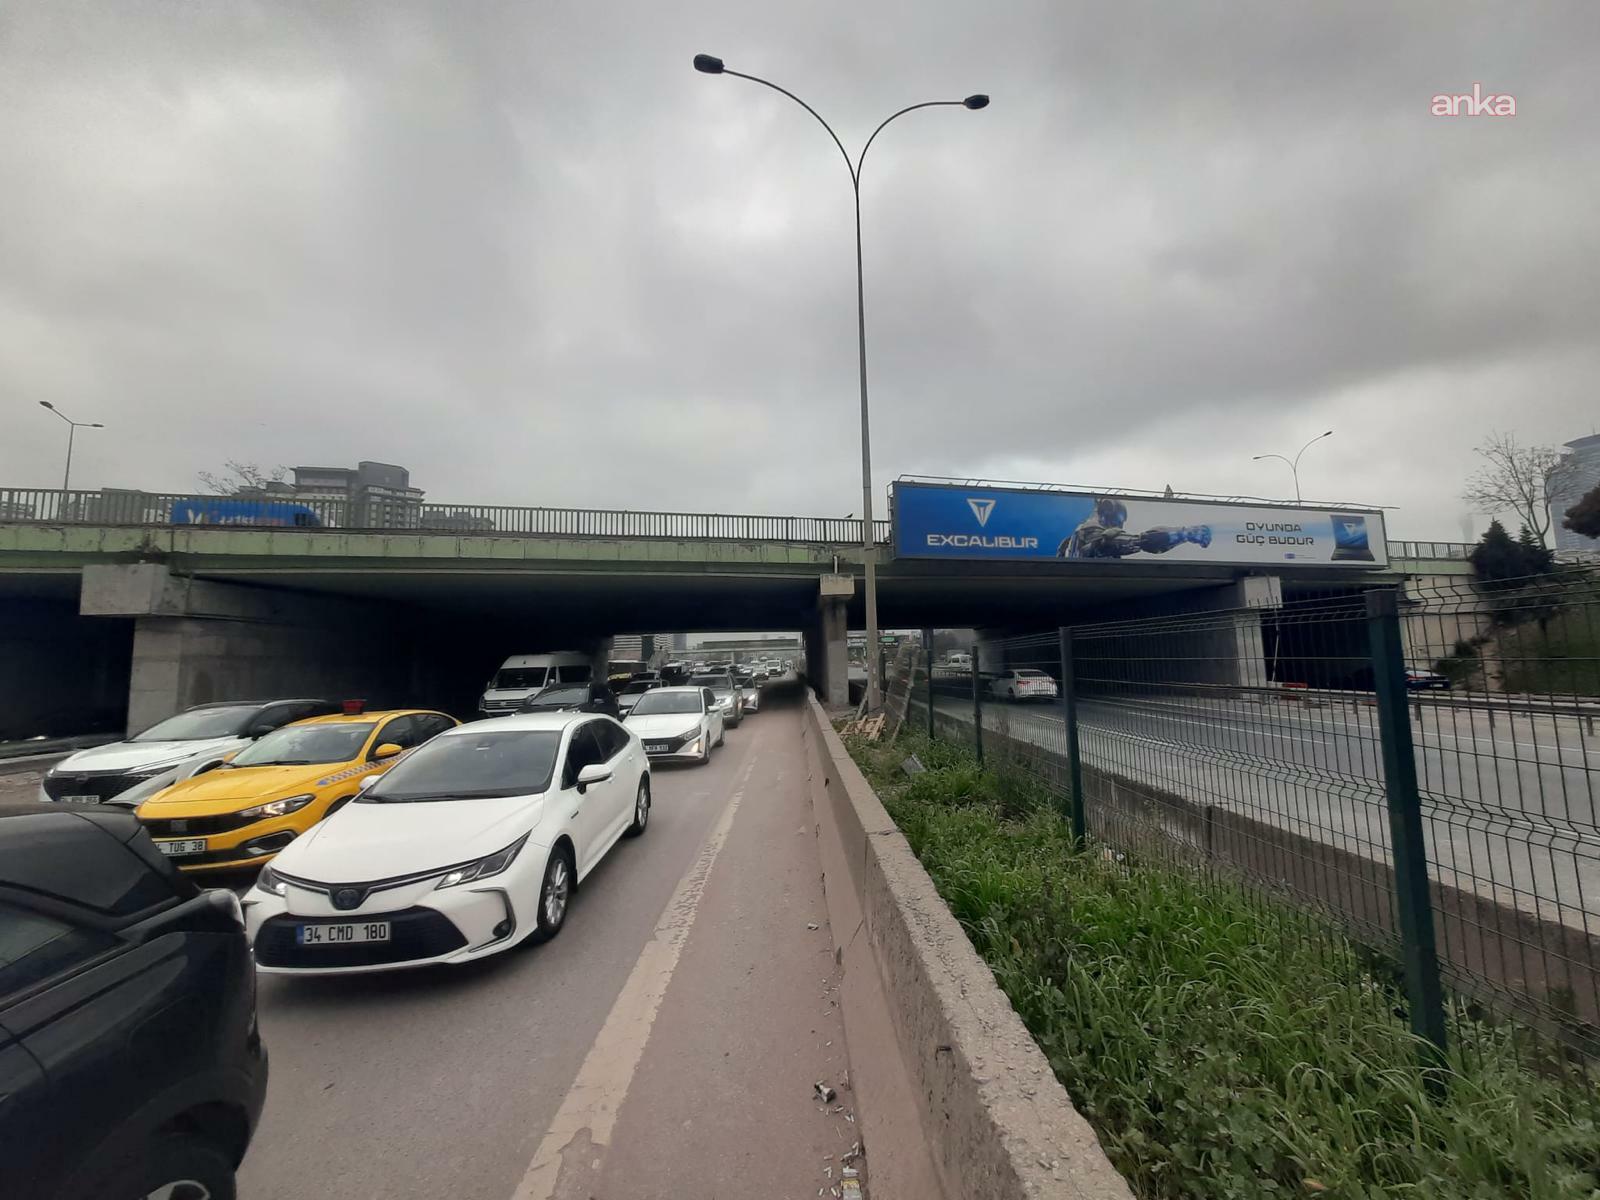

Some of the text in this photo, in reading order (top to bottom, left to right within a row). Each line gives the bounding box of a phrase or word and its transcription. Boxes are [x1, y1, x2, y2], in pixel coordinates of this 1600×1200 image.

[1245, 521, 1303, 532] OYUNDA
[926, 534, 1038, 549] EXCALIBUR
[1236, 533, 1315, 547] GÜÇ BUDUR
[168, 841, 186, 853] TUG
[191, 840, 203, 851] 38
[304, 923, 387, 942] 34 CMD 180
